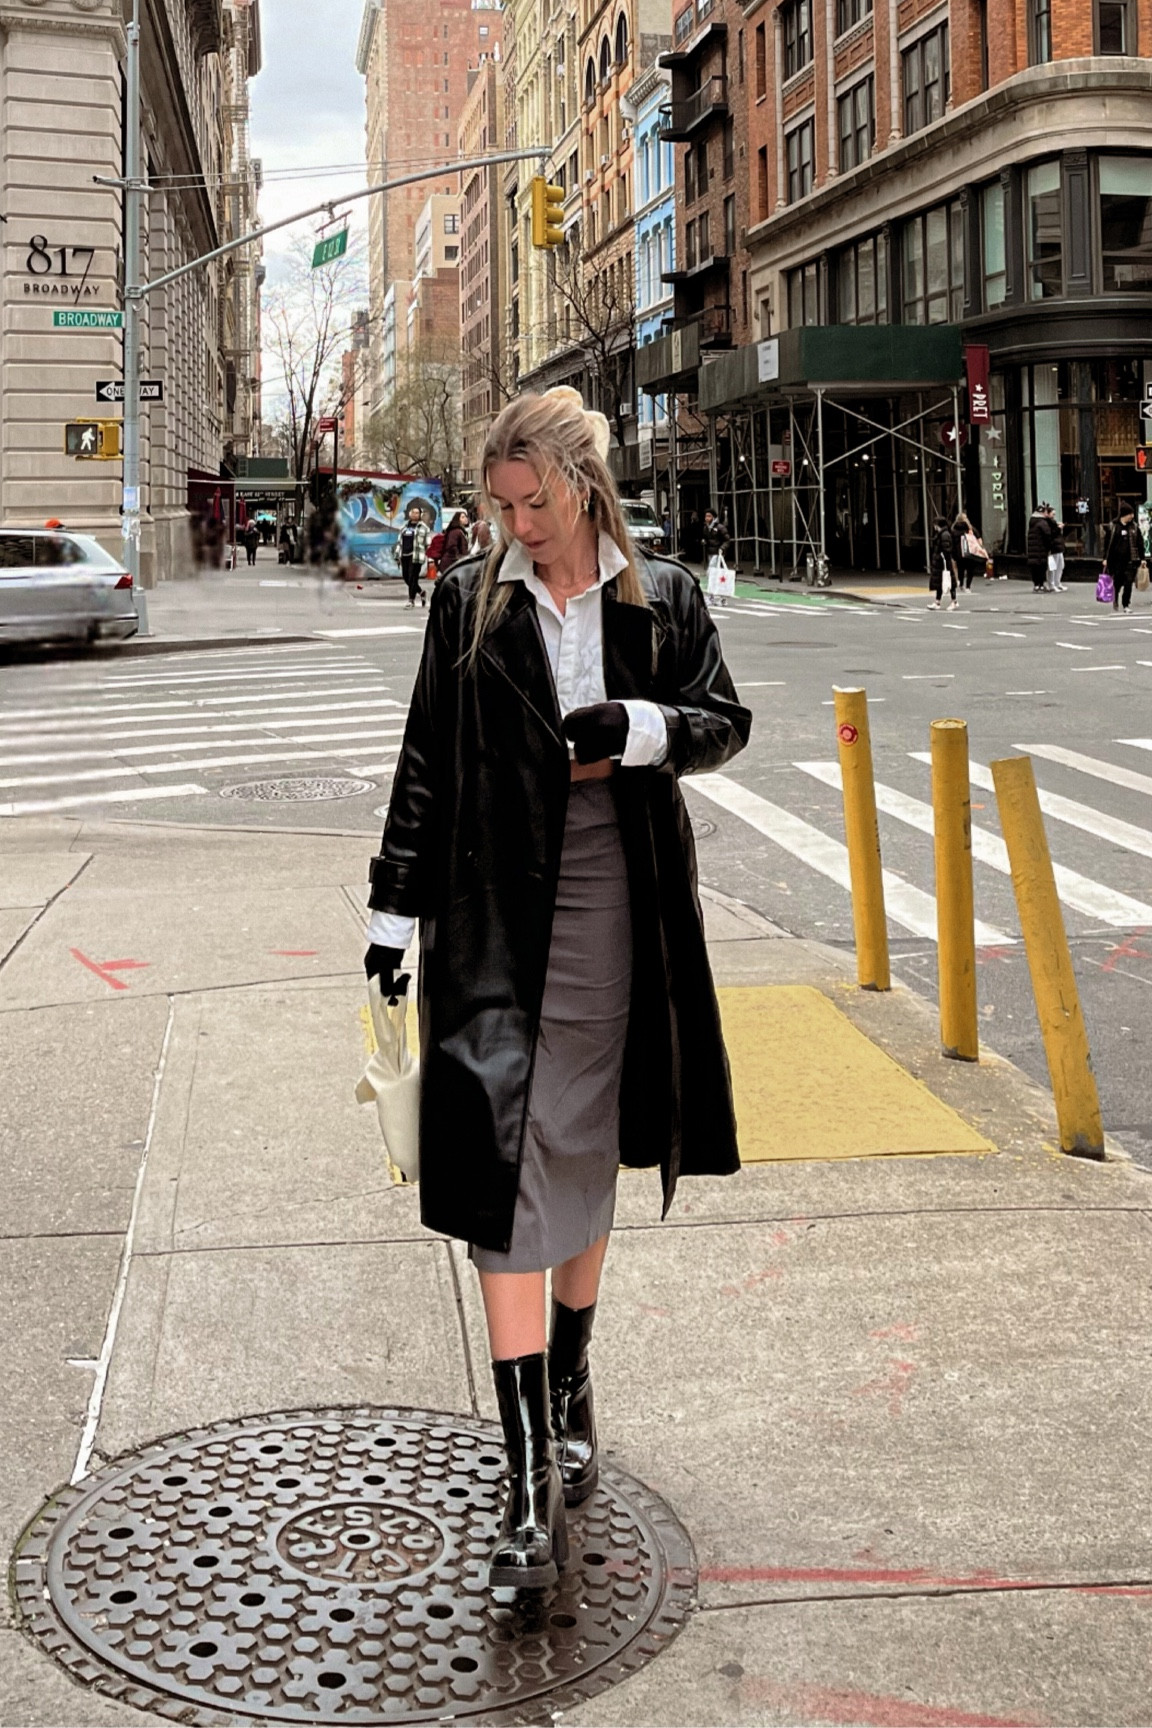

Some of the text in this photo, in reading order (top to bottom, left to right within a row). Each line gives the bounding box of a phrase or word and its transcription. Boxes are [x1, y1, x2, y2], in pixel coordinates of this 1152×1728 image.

[27, 235, 95, 304] 817
[24, 283, 100, 295] BROADWAY
[58, 312, 119, 325] BROADWAY
[106, 386, 125, 396] ONE
[972, 393, 988, 419] PRET
[991, 471, 1005, 512] PRET
